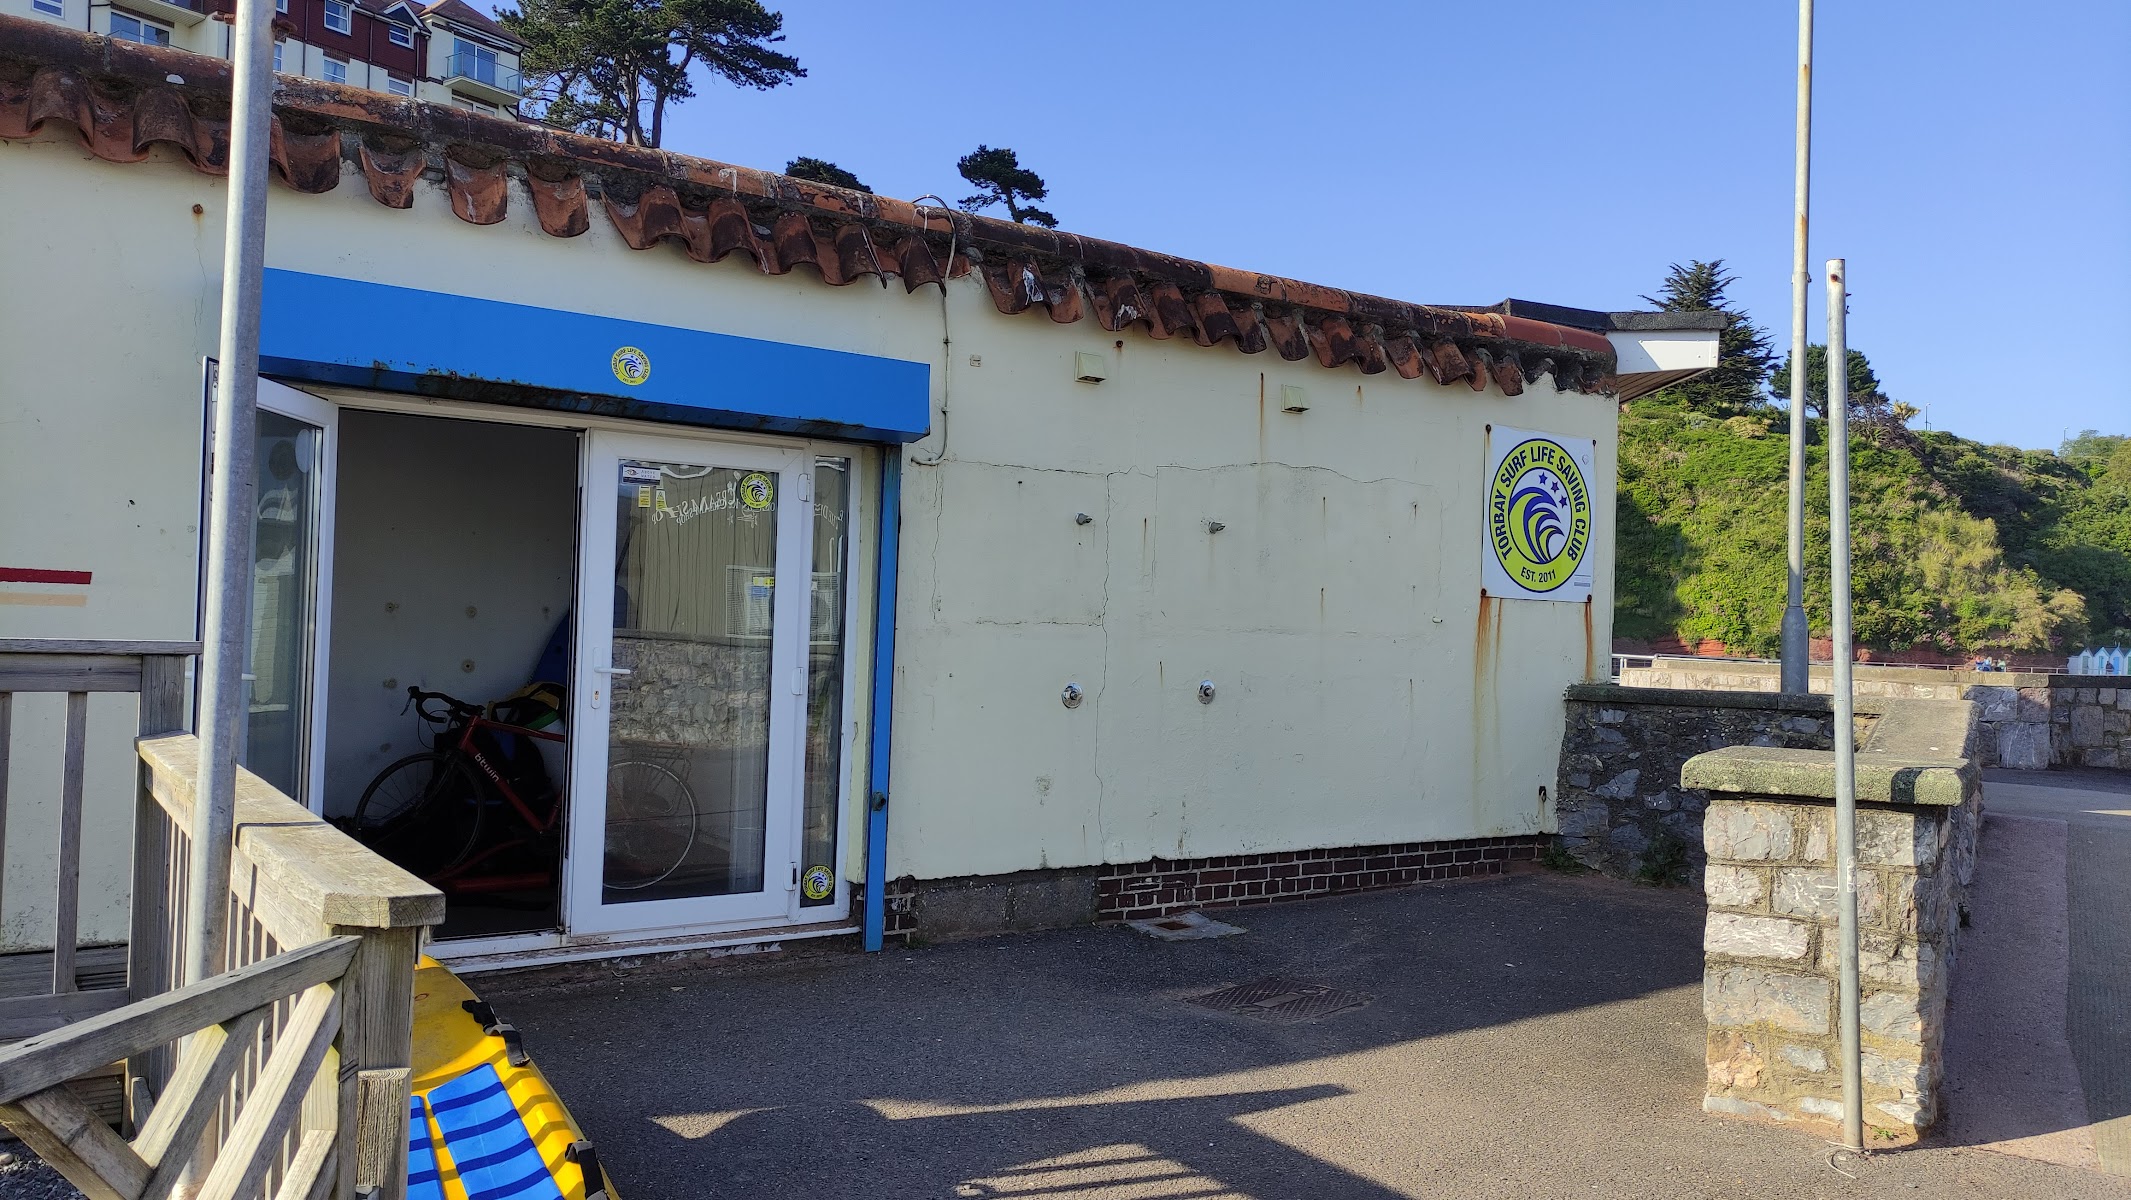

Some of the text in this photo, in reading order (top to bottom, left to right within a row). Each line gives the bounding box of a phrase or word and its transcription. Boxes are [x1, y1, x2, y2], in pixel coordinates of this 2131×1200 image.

[1500, 449, 1527, 488] SURF
[1530, 445, 1556, 466] LIFE
[1556, 456, 1586, 513] SAVING
[1494, 489, 1513, 561] TORBAY
[1567, 518, 1586, 561] CLUB
[1520, 566, 1557, 583] EST. 2011
